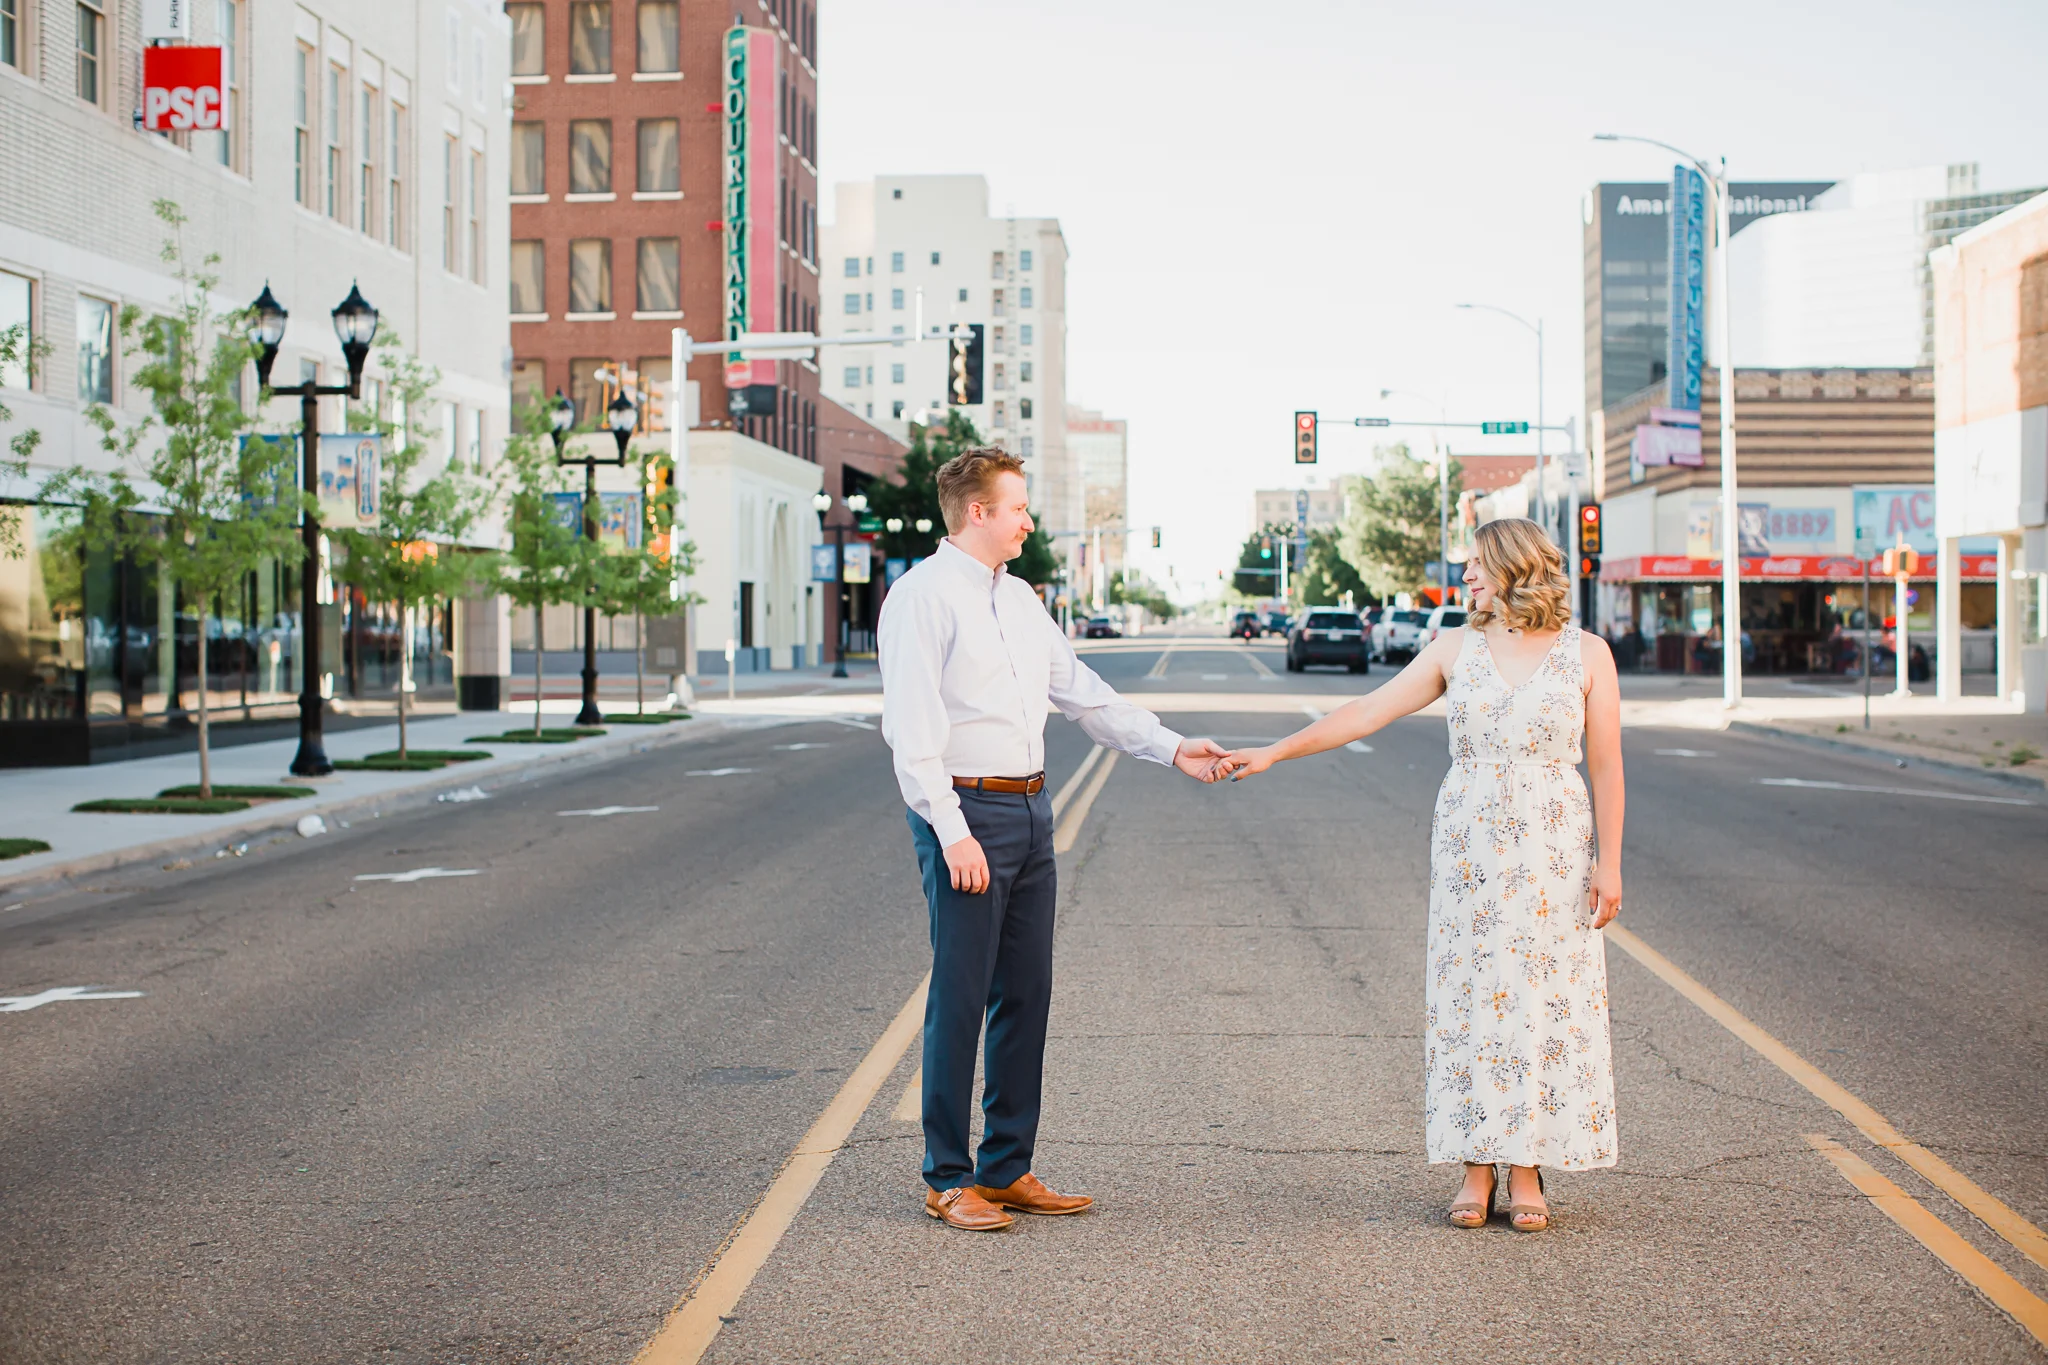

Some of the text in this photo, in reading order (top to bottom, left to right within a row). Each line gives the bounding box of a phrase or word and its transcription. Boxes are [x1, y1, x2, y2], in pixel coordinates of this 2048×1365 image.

[144, 86, 220, 129] PSC
[1686, 175, 1702, 398] ACAPULCO
[1771, 513, 1830, 537] 8889
